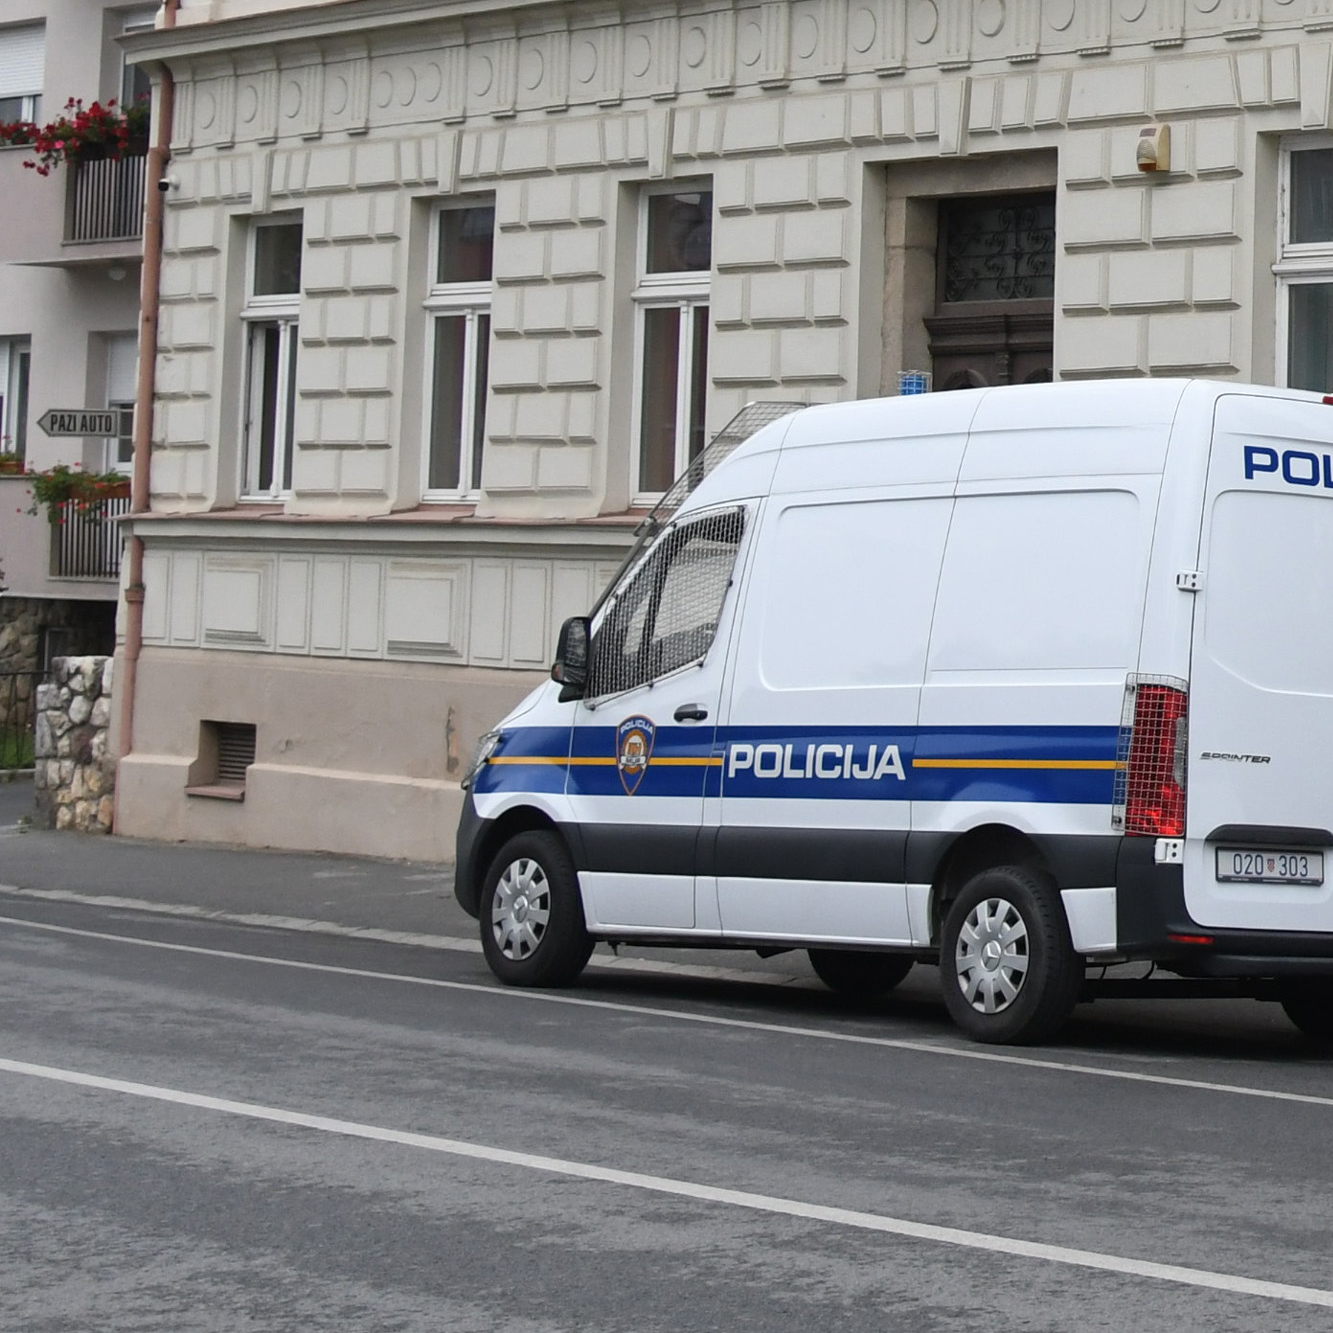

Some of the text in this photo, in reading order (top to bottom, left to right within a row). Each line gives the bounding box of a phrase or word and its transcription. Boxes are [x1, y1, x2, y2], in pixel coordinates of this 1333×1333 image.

[50, 414, 112, 433] PAZI AUTO
[728, 744, 906, 780] POLICIJA
[1233, 853, 1308, 877] 020 303
